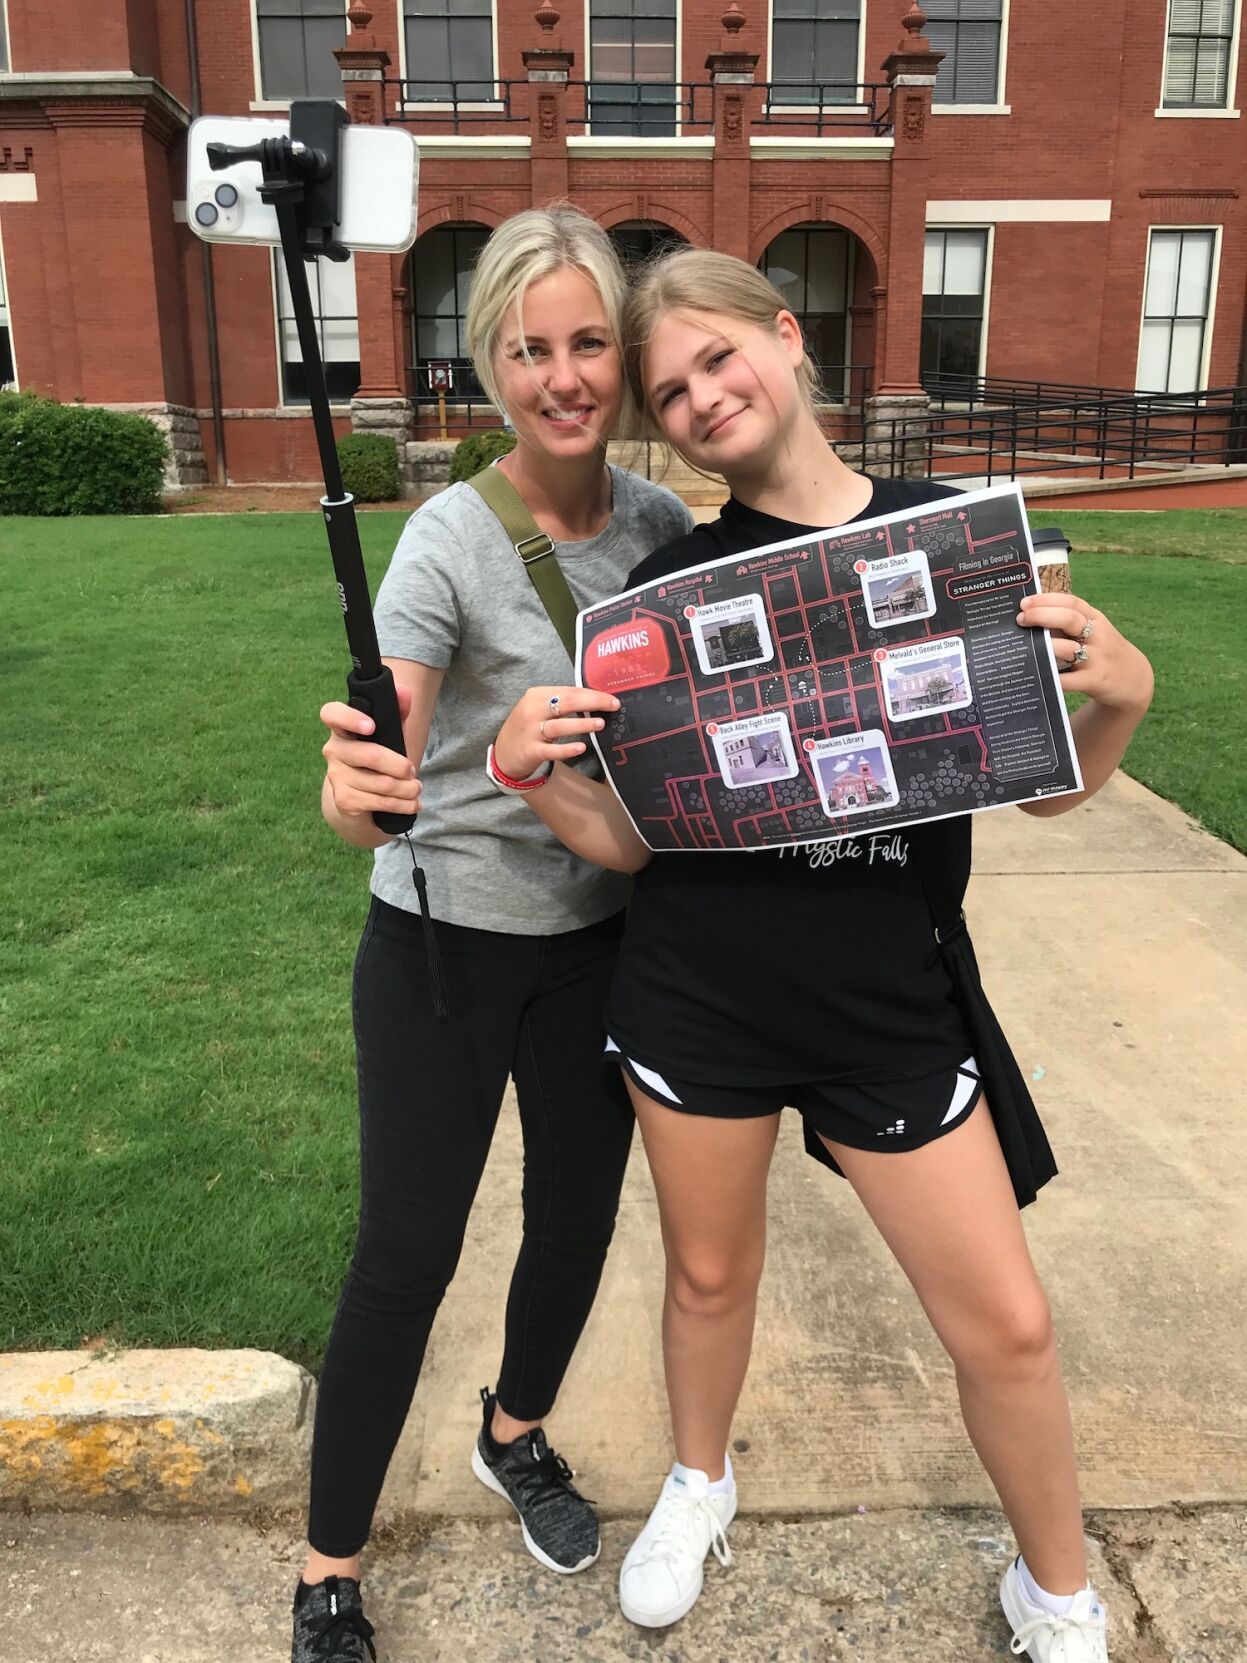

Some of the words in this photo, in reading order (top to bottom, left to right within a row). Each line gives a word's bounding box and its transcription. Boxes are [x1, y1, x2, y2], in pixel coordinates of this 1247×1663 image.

[942, 512, 953, 520] Mall
[840, 534, 861, 544] Hawkins
[862, 532, 872, 540] Lab
[768, 556, 784, 564] Middle
[784, 552, 800, 561] School
[871, 562, 889, 572] Radio
[889, 556, 909, 567] Shack
[958, 560, 982, 572] Filming
[982, 557, 989, 566] in
[990, 552, 1014, 564] Georgia
[953, 580, 996, 595] STRANGER
[996, 572, 1027, 584] THINGS
[698, 607, 713, 617] Hawk
[714, 604, 731, 612] Movie
[732, 598, 753, 609] Theatre
[597, 630, 650, 658] HAWKINS
[890, 648, 918, 660] Melvald's
[919, 642, 942, 654] General
[943, 640, 960, 649] Store
[735, 723, 748, 731] Alley
[749, 719, 763, 729] Fight
[764, 716, 782, 724] Scene
[817, 740, 842, 750] Hawkins
[842, 736, 864, 745] Library
[868, 834, 909, 867] Falls
